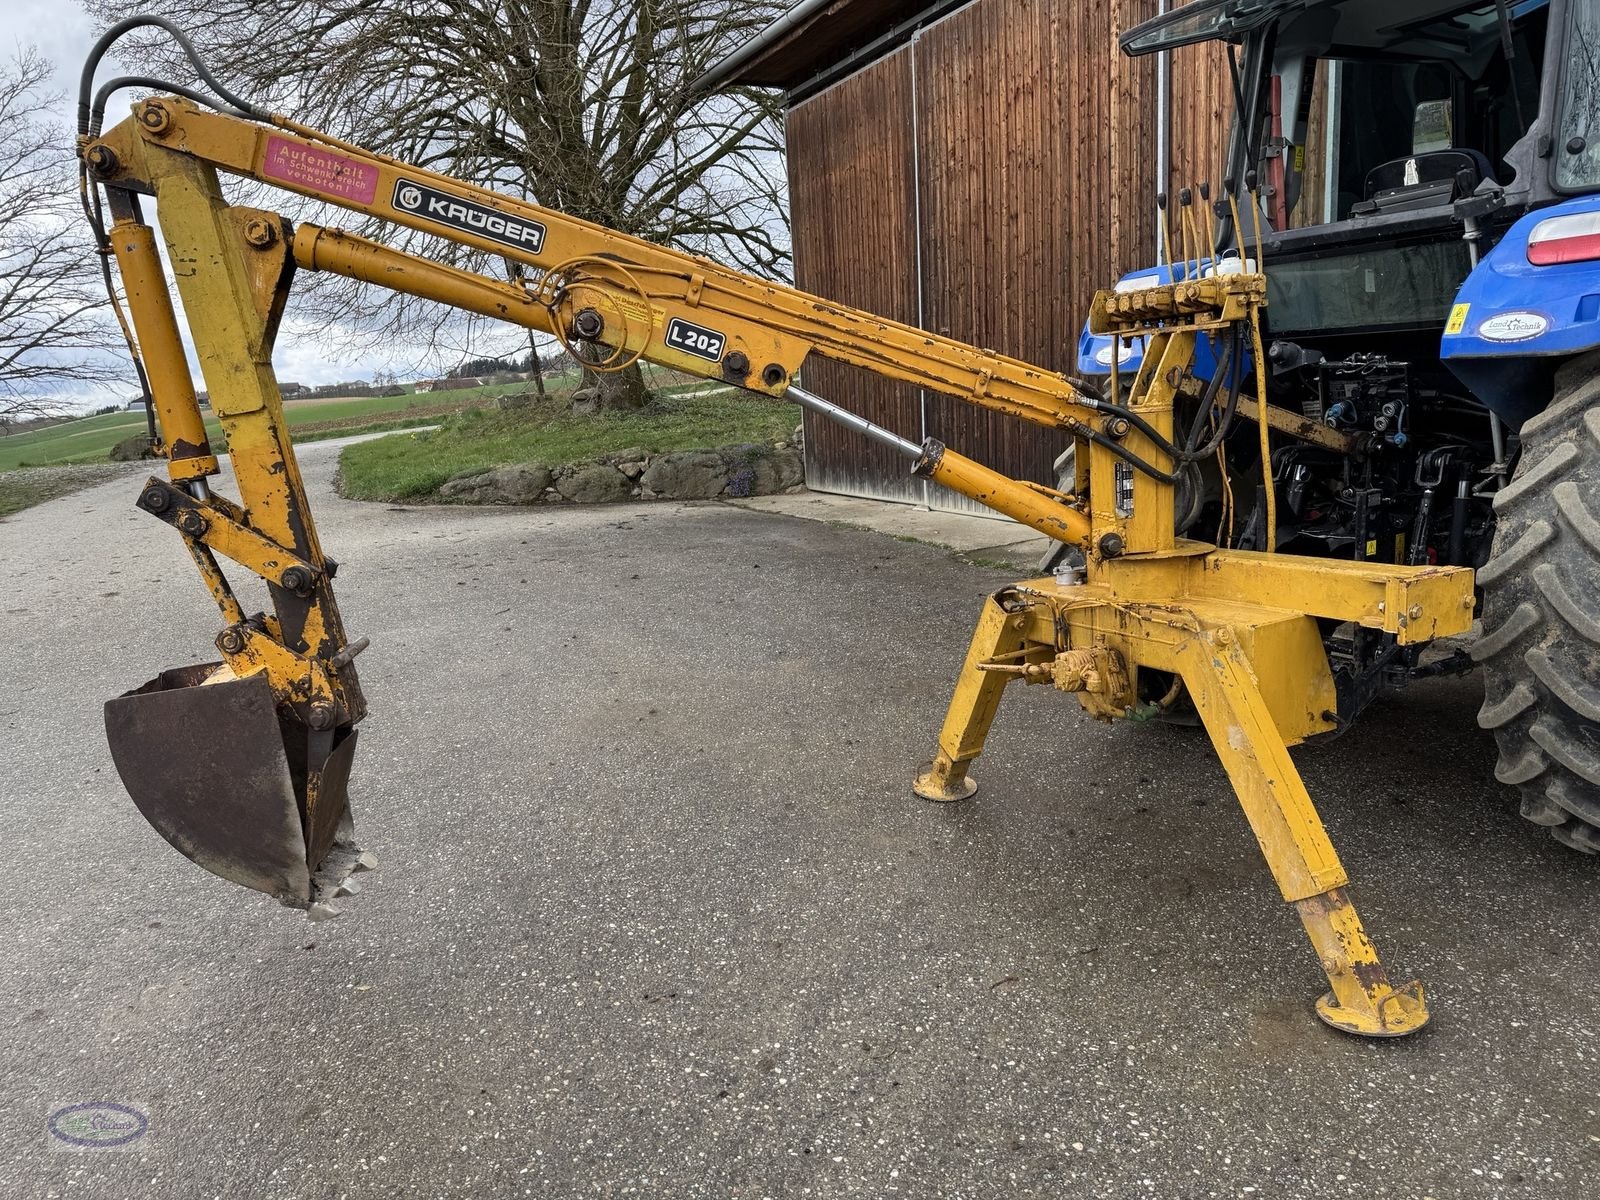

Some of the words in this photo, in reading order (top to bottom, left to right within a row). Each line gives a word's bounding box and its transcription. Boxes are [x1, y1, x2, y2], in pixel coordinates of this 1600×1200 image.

[273, 154, 286, 166] im
[289, 159, 367, 190] Schwenkbereich
[279, 145, 364, 180] Aufenthalt
[286, 168, 350, 193] verboten!
[428, 197, 541, 246] KRÜGER
[671, 326, 683, 343] L
[684, 331, 720, 355] 202
[1489, 320, 1508, 328] Land
[1512, 321, 1541, 331] Technik
